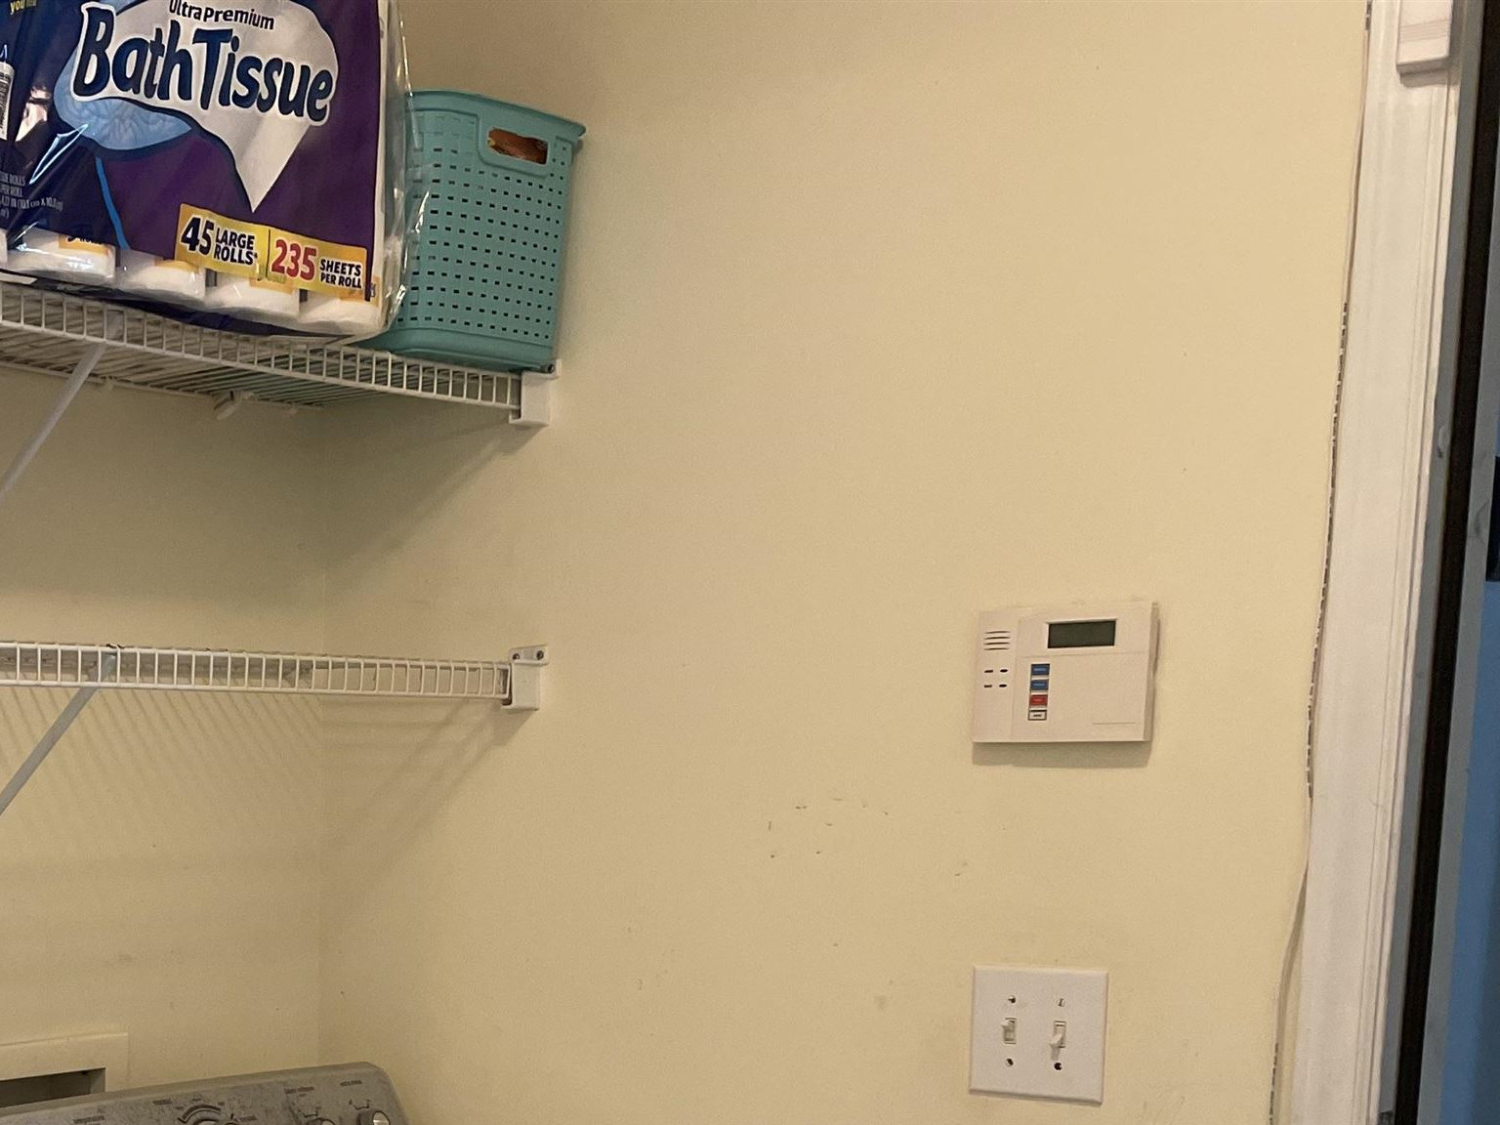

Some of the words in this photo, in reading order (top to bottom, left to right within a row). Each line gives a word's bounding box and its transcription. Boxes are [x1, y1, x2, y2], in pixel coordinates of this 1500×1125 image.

[169, 0, 201, 20] Ultra
[203, 7, 274, 30] Premium
[181, 216, 215, 256] 45
[215, 227, 256, 251] LARGE
[271, 239, 317, 281] 235
[319, 258, 362, 277] SHEETS
[320, 273, 336, 285] PER
[337, 275, 363, 289] ROLL
